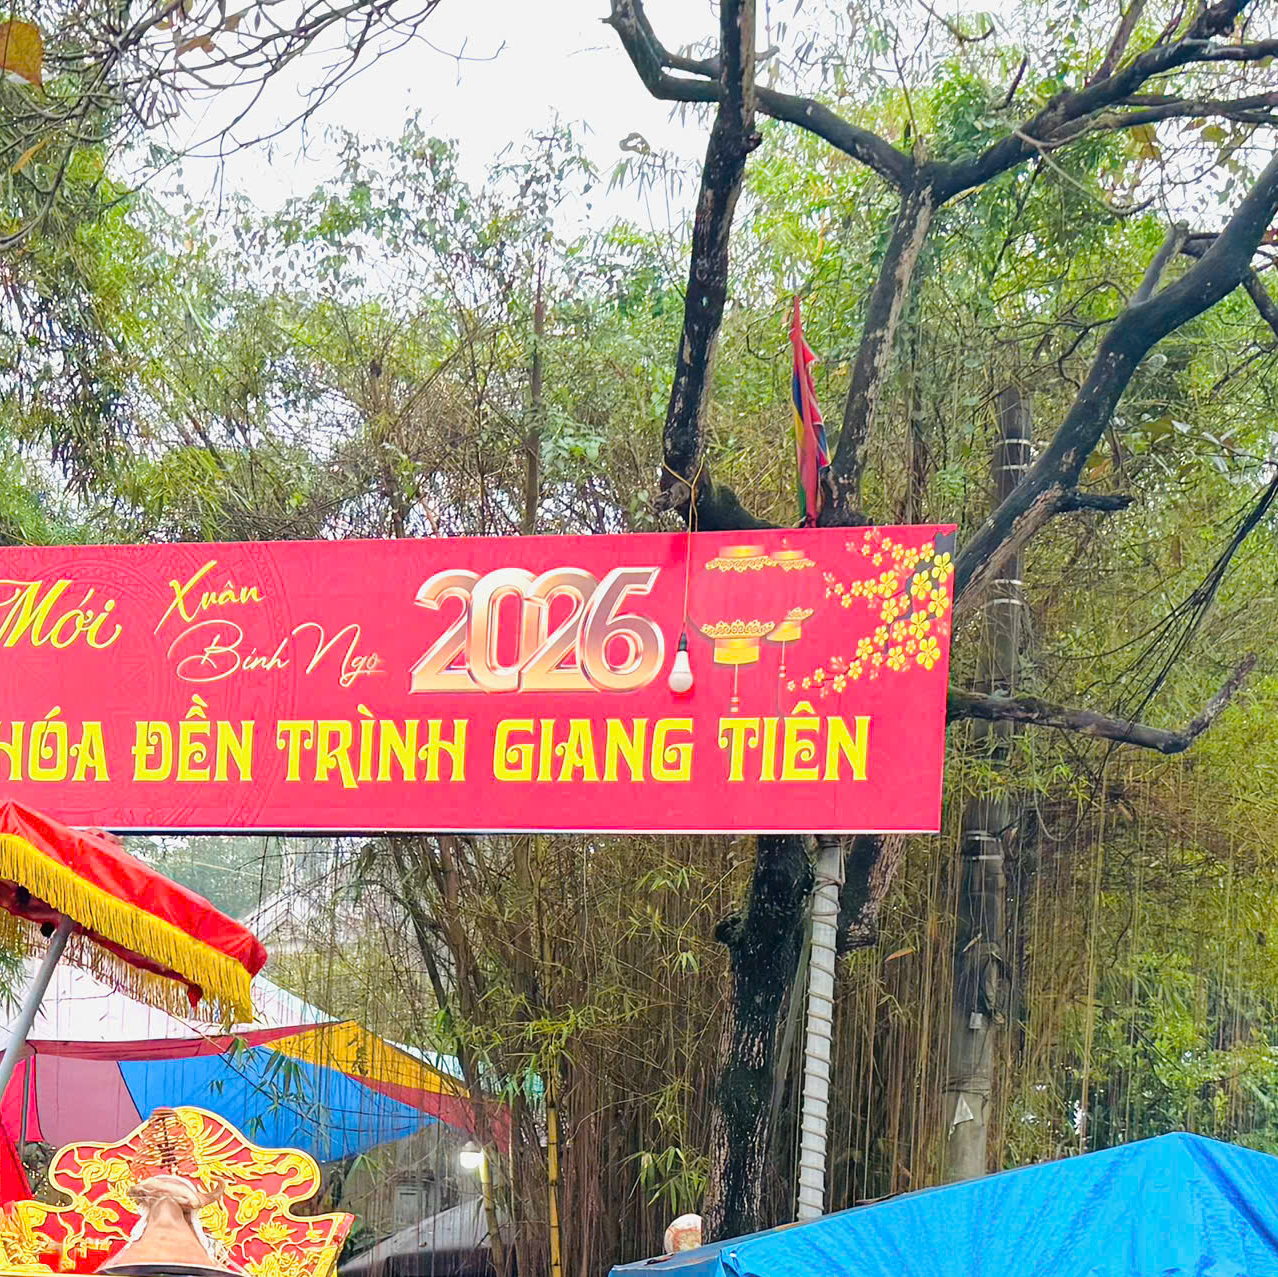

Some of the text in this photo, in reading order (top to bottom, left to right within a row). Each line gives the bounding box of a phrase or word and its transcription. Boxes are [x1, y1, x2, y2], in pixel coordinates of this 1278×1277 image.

[154, 560, 265, 634] Xuân
[409, 567, 665, 694] 2026
[167, 619, 384, 687] Bính Ngọ
[132, 693, 255, 782] ĐỀN
[276, 704, 469, 788] TRÌNH
[493, 718, 694, 782] GIANG
[718, 700, 871, 782] TIÊN
